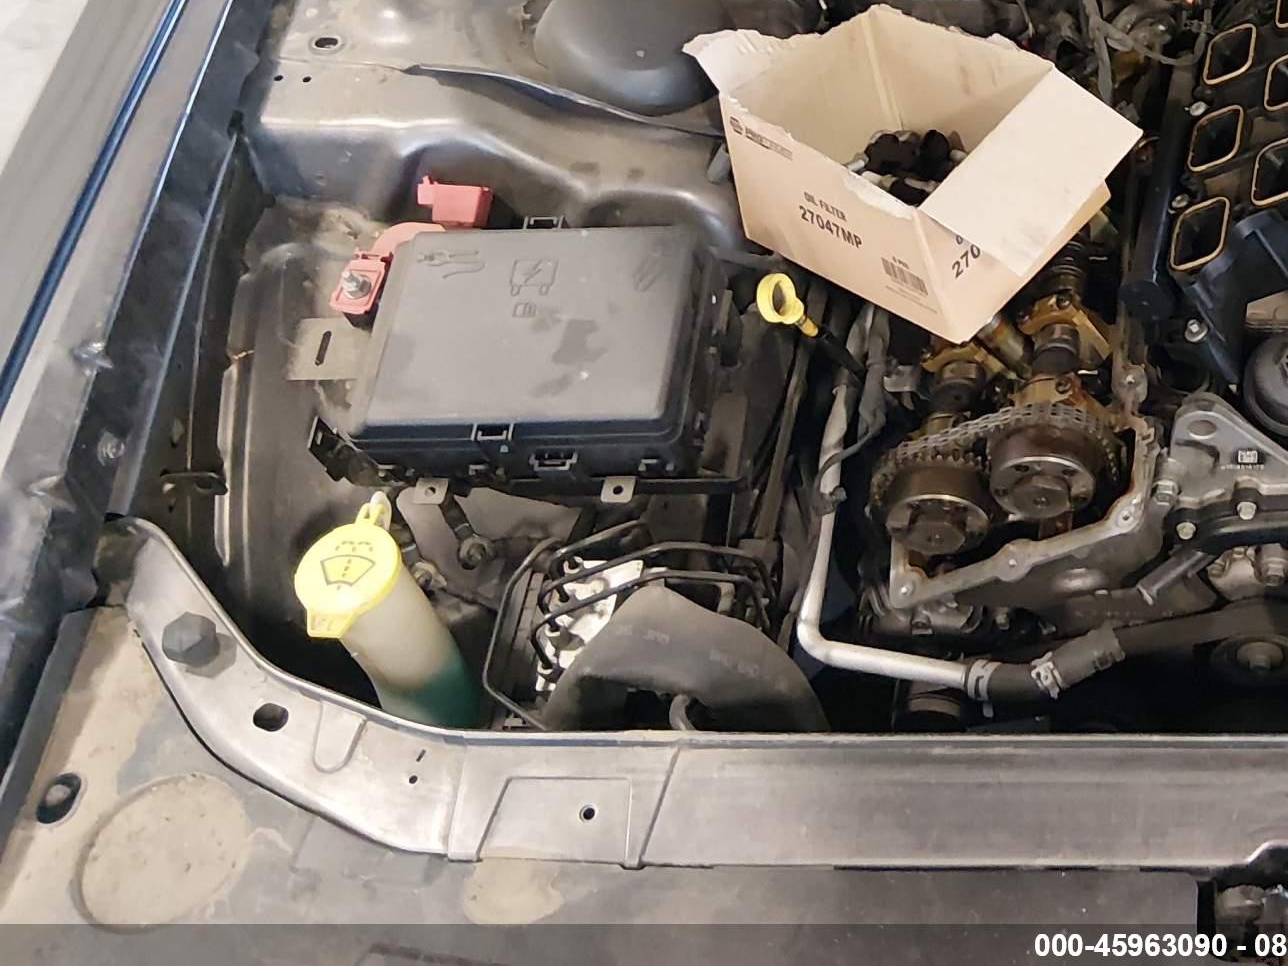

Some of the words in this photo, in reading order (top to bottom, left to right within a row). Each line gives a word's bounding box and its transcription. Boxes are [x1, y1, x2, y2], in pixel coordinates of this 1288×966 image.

[803, 191, 819, 207] OIL
[819, 199, 848, 223] FILTER
[798, 204, 863, 249] 27047MP
